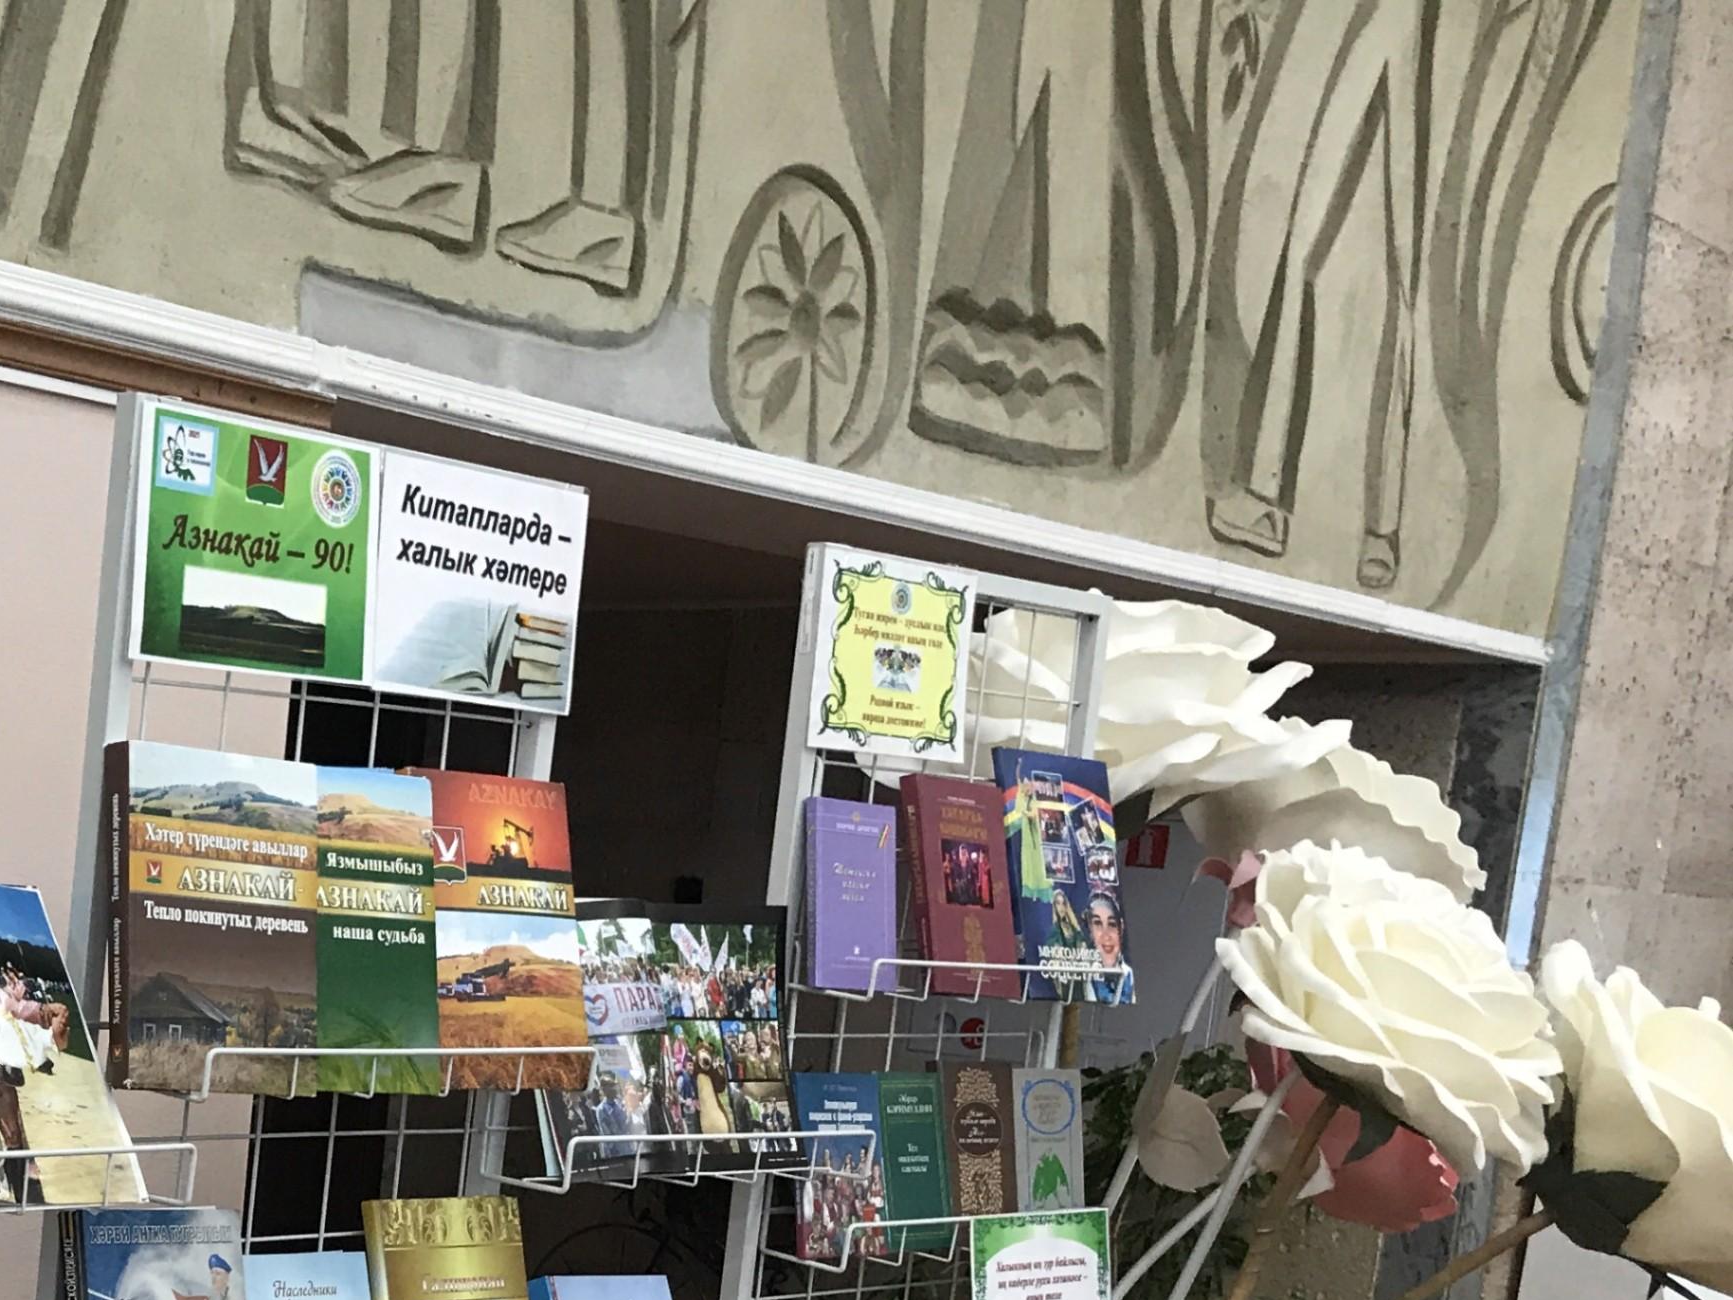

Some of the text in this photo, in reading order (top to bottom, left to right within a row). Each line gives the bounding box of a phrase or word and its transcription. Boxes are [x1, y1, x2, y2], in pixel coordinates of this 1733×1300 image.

[401, 483, 554, 546] Китапларда
[313, 538, 354, 573] 90!
[396, 538, 567, 598] халык хәтере
[468, 782, 557, 811] AZNAKAY
[145, 822, 309, 861] Хәтер түрендәге авыллар
[325, 851, 424, 877] Язмышыбыз
[477, 880, 569, 912] АЗНАКАЙ
[144, 900, 309, 938] Тепло покинутых деревень
[333, 924, 426, 947] наша судьба
[89, 1226, 132, 1245] ХӘРБИ
[273, 1280, 338, 1299] Наследники
